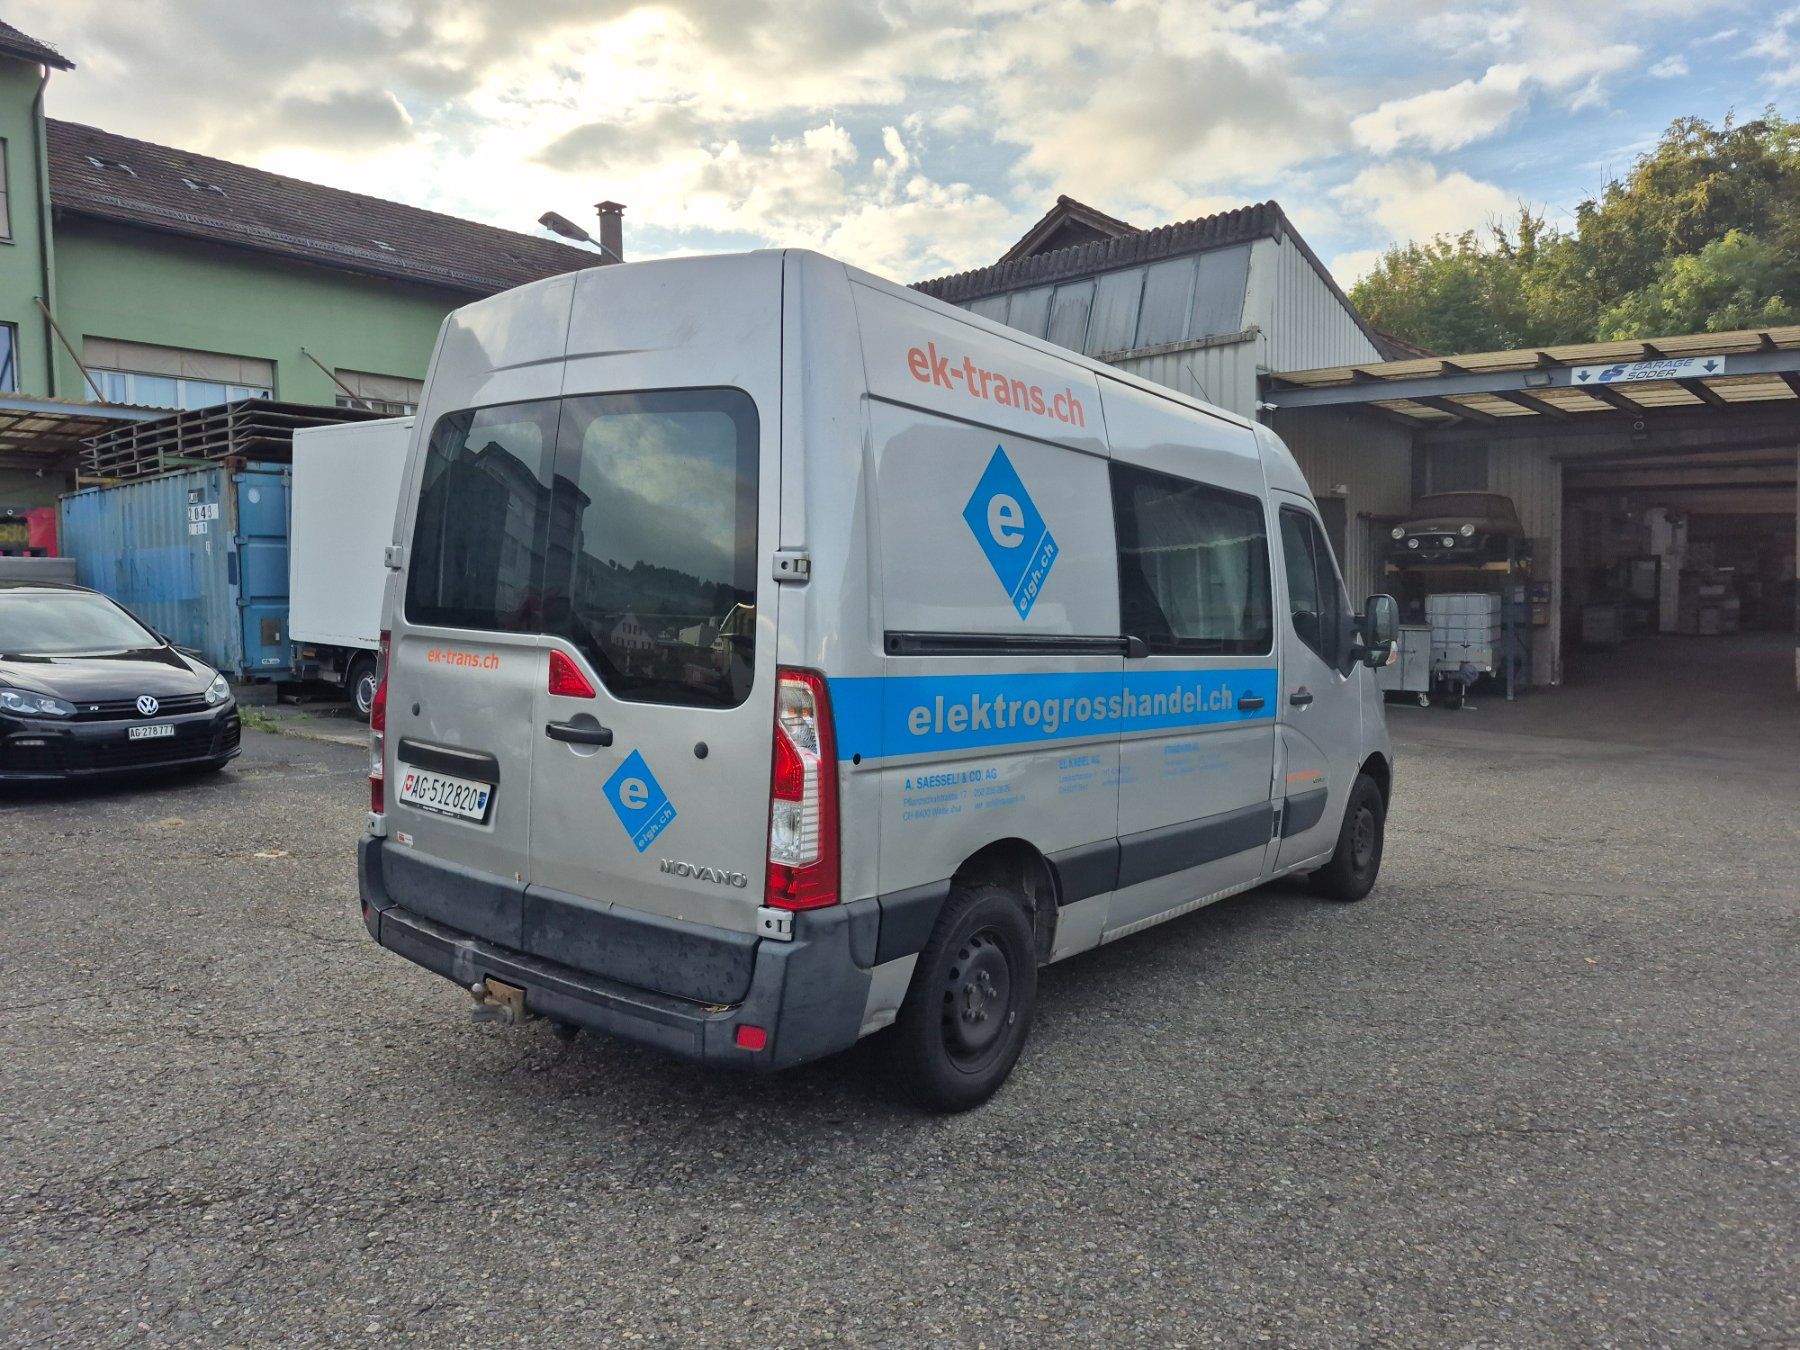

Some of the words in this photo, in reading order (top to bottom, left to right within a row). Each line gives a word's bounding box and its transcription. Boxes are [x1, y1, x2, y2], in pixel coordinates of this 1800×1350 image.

[1626, 368, 1677, 380] SODER
[1632, 358, 1696, 371] GARAGE
[907, 341, 1086, 428] ek-trans.ch
[987, 493, 1025, 548] e
[1019, 543, 1055, 611] elgh.ch
[427, 648, 499, 670] ek-trans.ch
[907, 683, 1233, 736] elektrogrosshandel.ch
[986, 768, 998, 780] AG
[618, 777, 649, 810] e
[638, 809, 672, 848] elgh.ch
[659, 858, 748, 889] MOVANO
